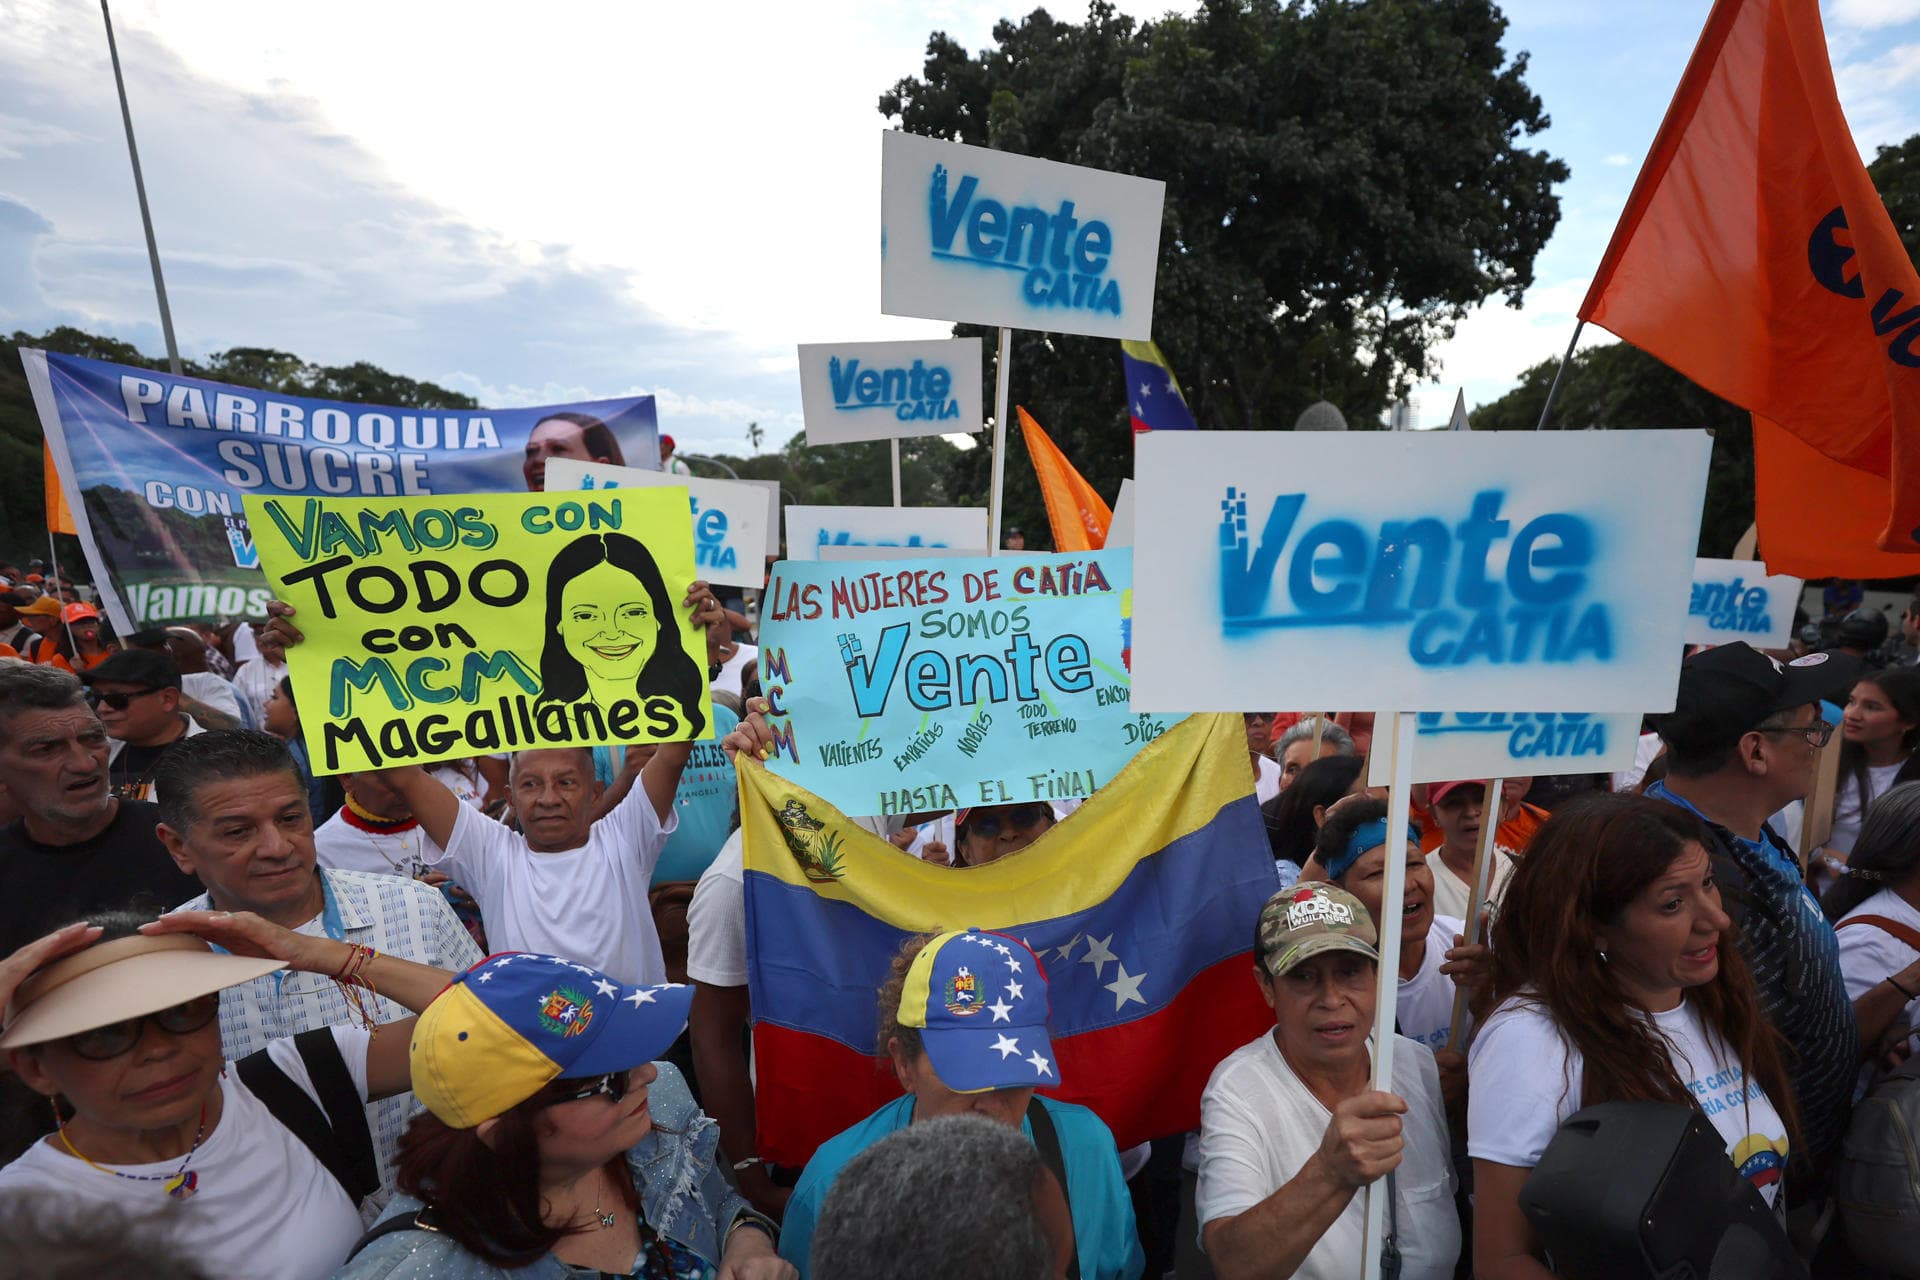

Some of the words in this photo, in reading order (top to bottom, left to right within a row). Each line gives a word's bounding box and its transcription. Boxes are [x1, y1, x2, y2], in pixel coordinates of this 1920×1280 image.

[929, 163, 1113, 276] Vente
[1022, 268, 1122, 317] CATIA
[829, 355, 952, 404] Vente
[120, 374, 502, 452] PARROQUIA
[895, 400, 960, 421] CATIA
[217, 439, 431, 496] SUCRE
[145, 480, 232, 516] CON
[263, 497, 499, 563] VAMOS
[520, 498, 623, 535] CON
[1219, 485, 1594, 618] Vente
[126, 583, 273, 623] Vamos
[280, 555, 530, 619] TODO
[771, 575, 823, 622] LAS
[831, 569, 950, 619] MUJERES
[962, 568, 1003, 604] DE
[919, 605, 1031, 640] SOMOS
[1409, 603, 1617, 668] CATIA
[1708, 611, 1772, 633] CATIA
[328, 650, 544, 719] MCM
[836, 621, 1095, 719] Vente
[1016, 703, 1048, 719] TODO
[1023, 717, 1077, 740] TERRENO
[1508, 722, 1606, 759] CATIA
[879, 783, 959, 816] HASTA
[977, 779, 1014, 803] EL
